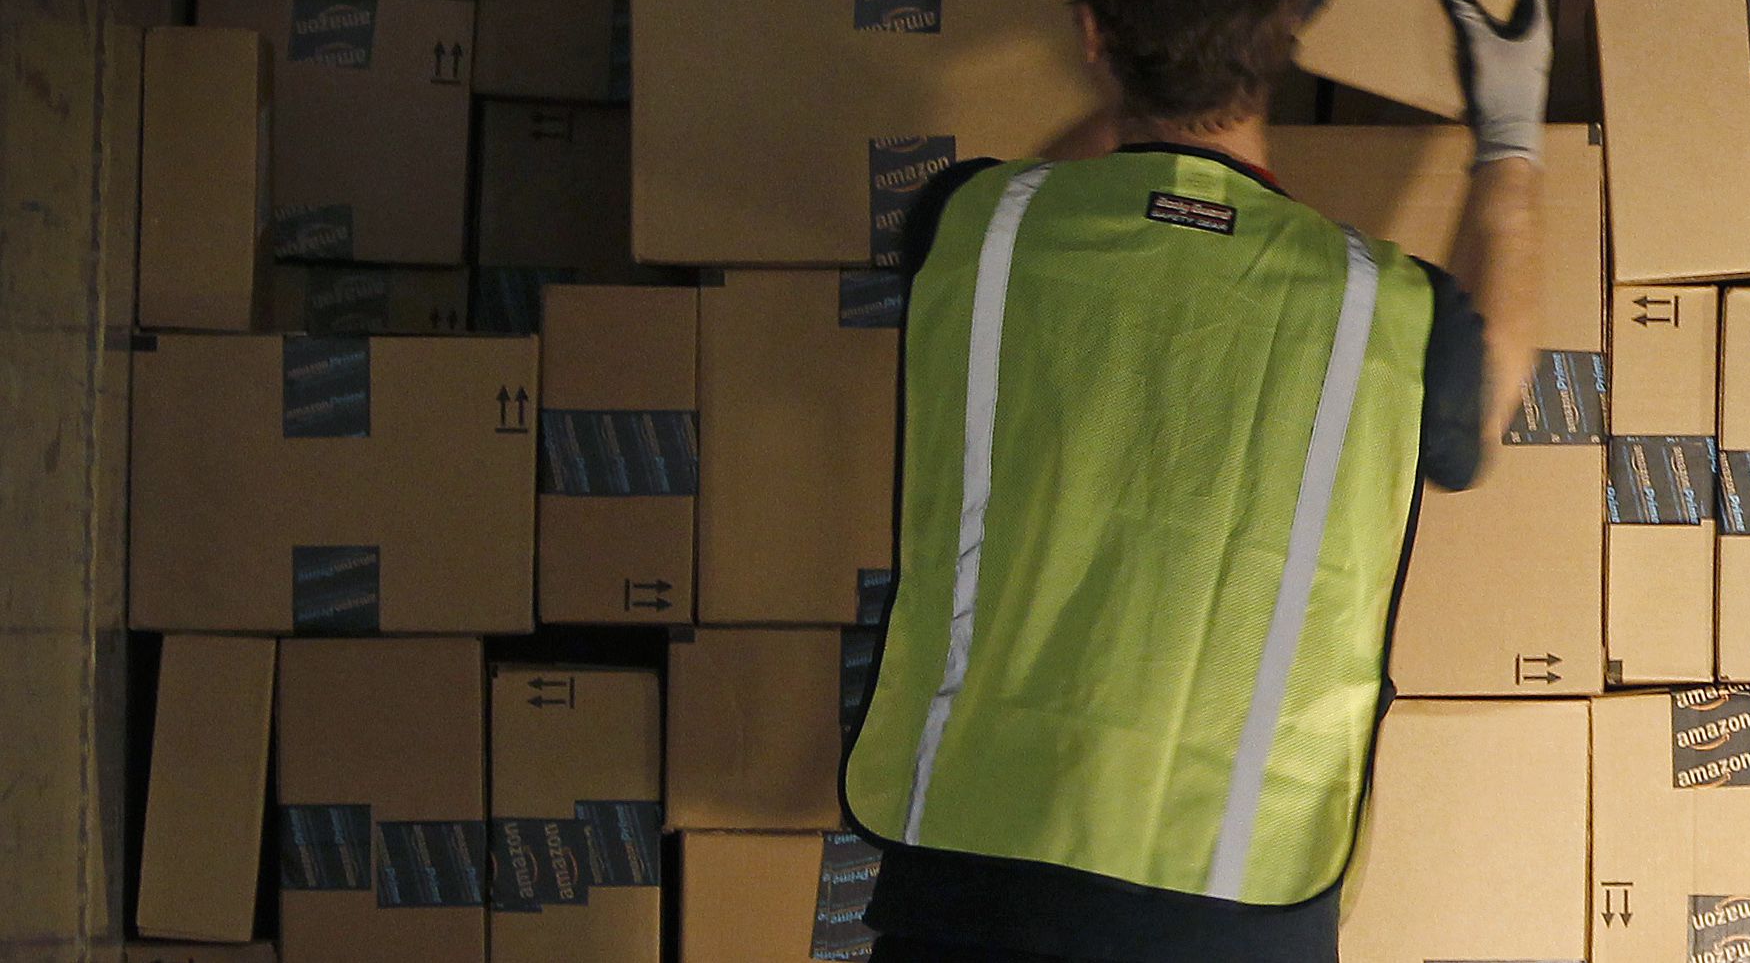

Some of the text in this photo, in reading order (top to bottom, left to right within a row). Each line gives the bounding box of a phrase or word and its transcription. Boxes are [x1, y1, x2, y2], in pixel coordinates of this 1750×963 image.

[875, 156, 949, 188] amazon
[504, 822, 533, 900] amazon
[545, 823, 574, 900] amazon
